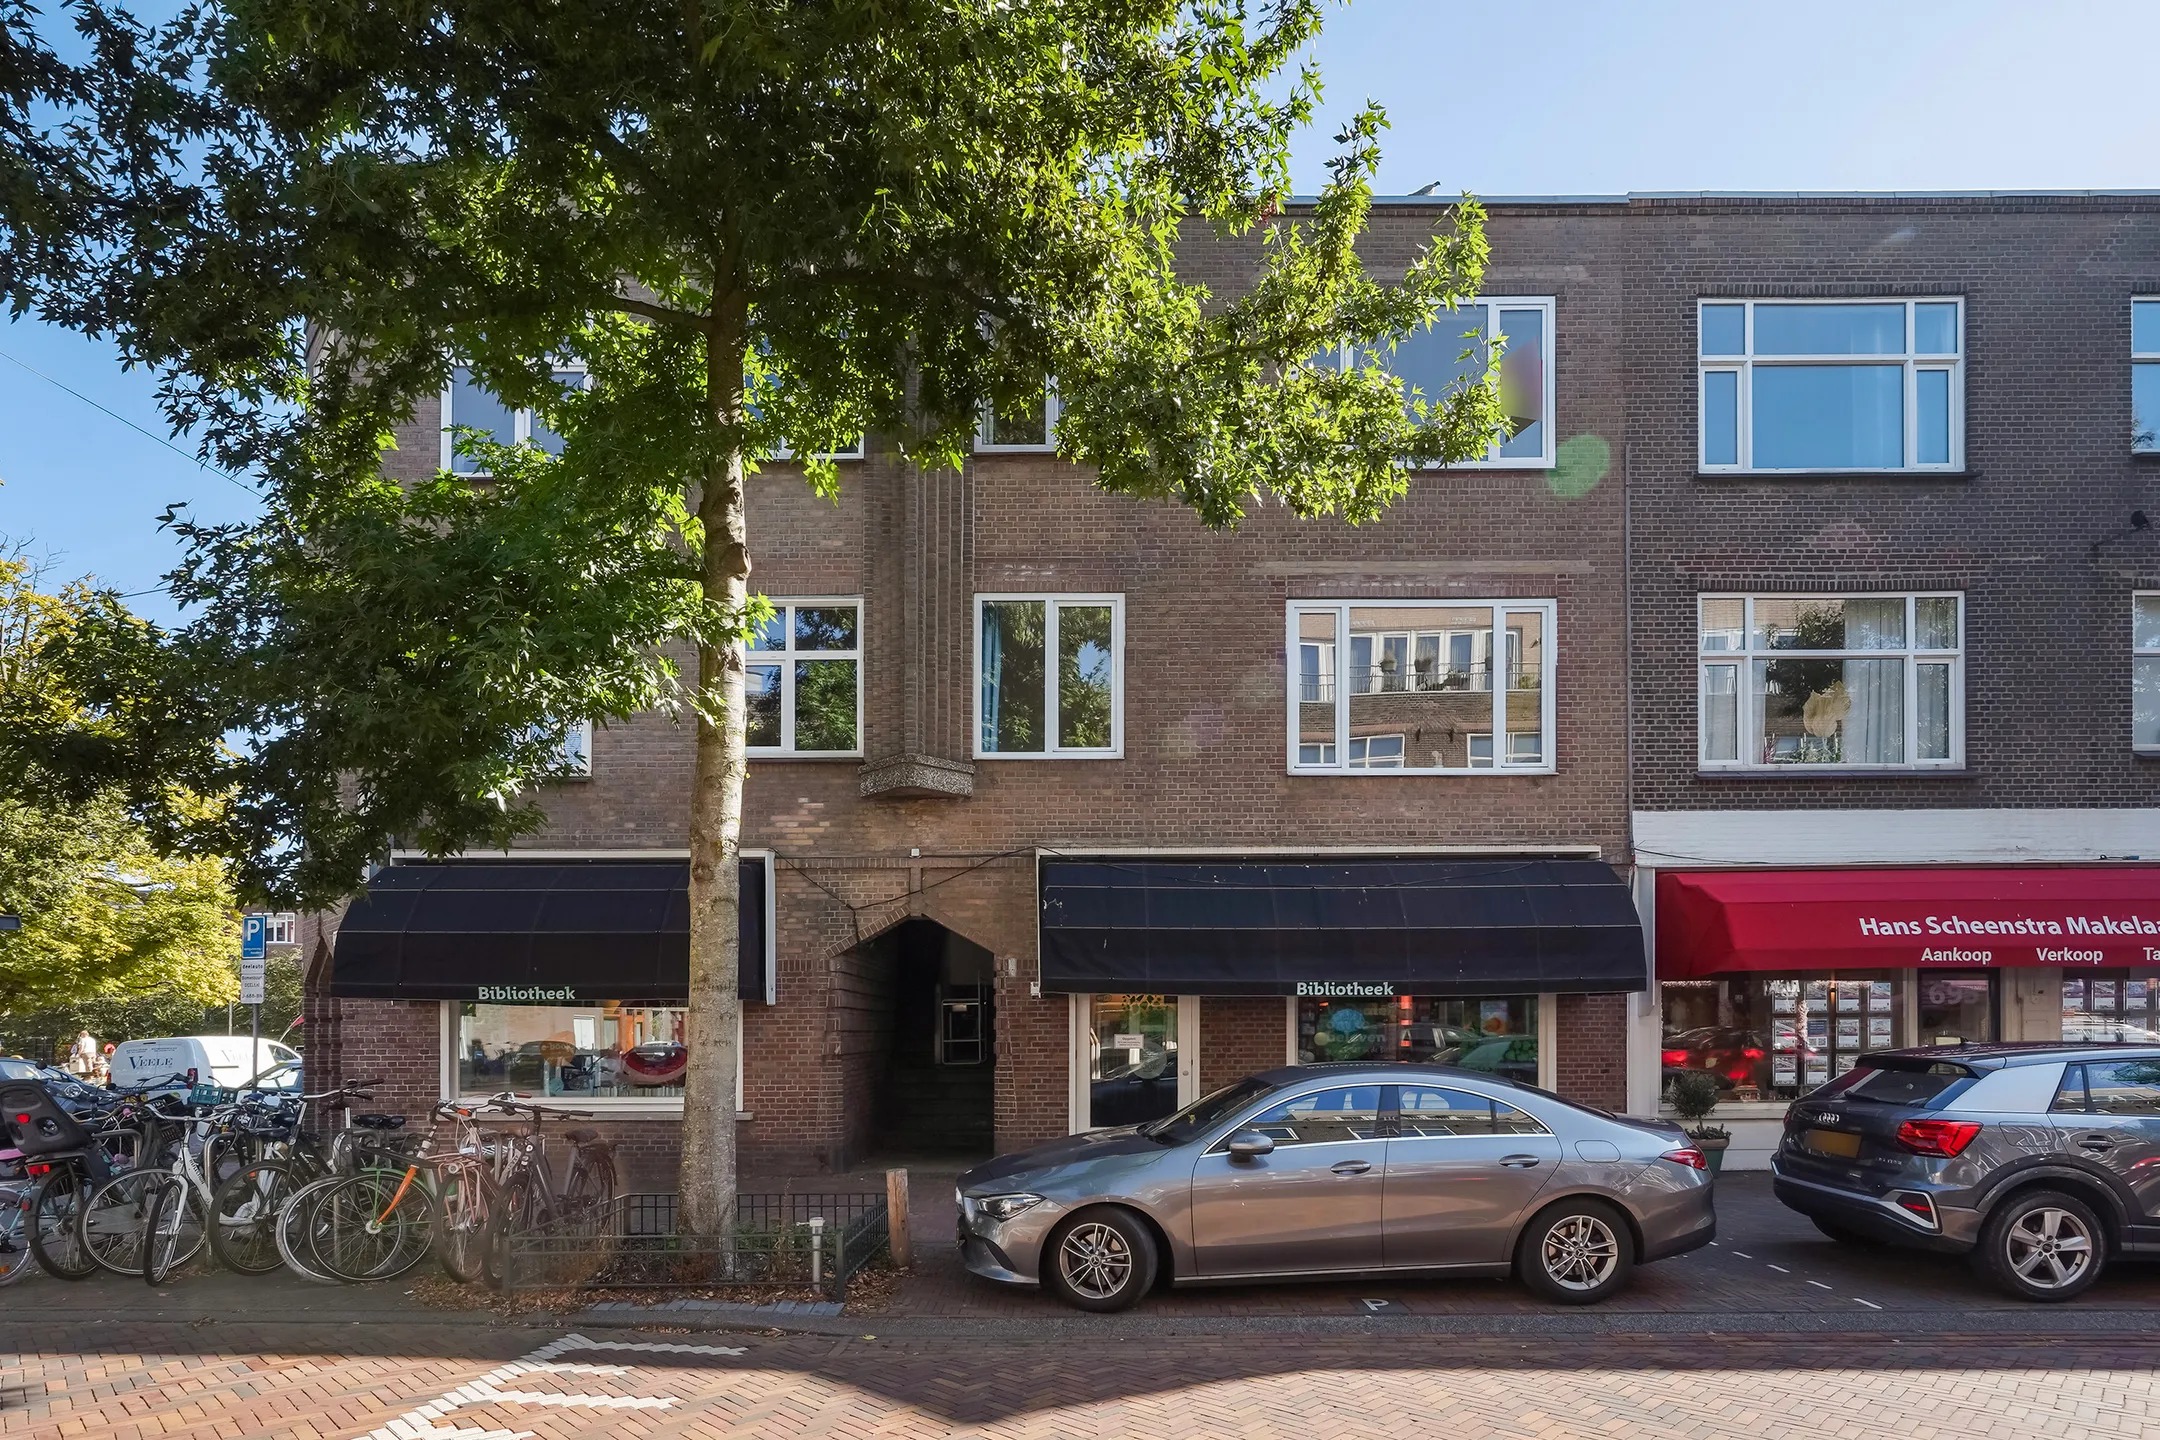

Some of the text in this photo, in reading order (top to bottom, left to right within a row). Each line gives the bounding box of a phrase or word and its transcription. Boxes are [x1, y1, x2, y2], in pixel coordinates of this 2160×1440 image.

[247, 919, 260, 941] P
[1859, 915, 2160, 935] Hans Scheenstra Makela
[1921, 946, 1992, 965] Aankoop
[2036, 946, 2104, 965] Verkoop
[478, 985, 576, 1000] Bibliotheek
[1296, 981, 1394, 996] Bibliotheek
